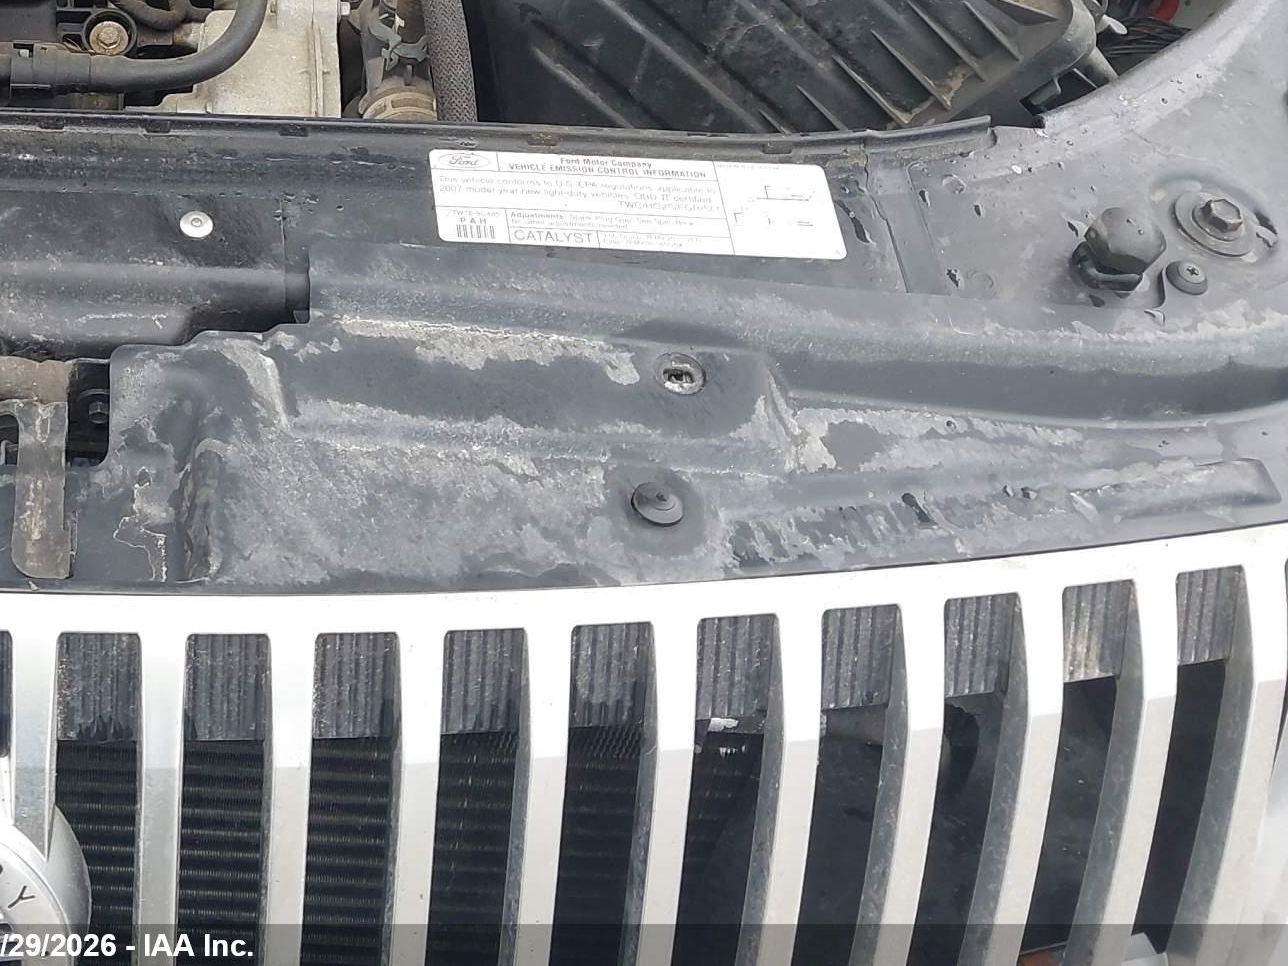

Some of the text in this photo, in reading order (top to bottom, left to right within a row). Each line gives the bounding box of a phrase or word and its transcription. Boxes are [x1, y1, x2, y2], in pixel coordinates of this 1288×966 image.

[449, 154, 479, 166] Ford
[560, 157, 652, 169] Ford Motor Company
[508, 163, 707, 178] VEHICLE EMISSION CONTROL INFORMATION
[439, 184, 462, 192] 2007
[513, 229, 593, 243] CATALYST
